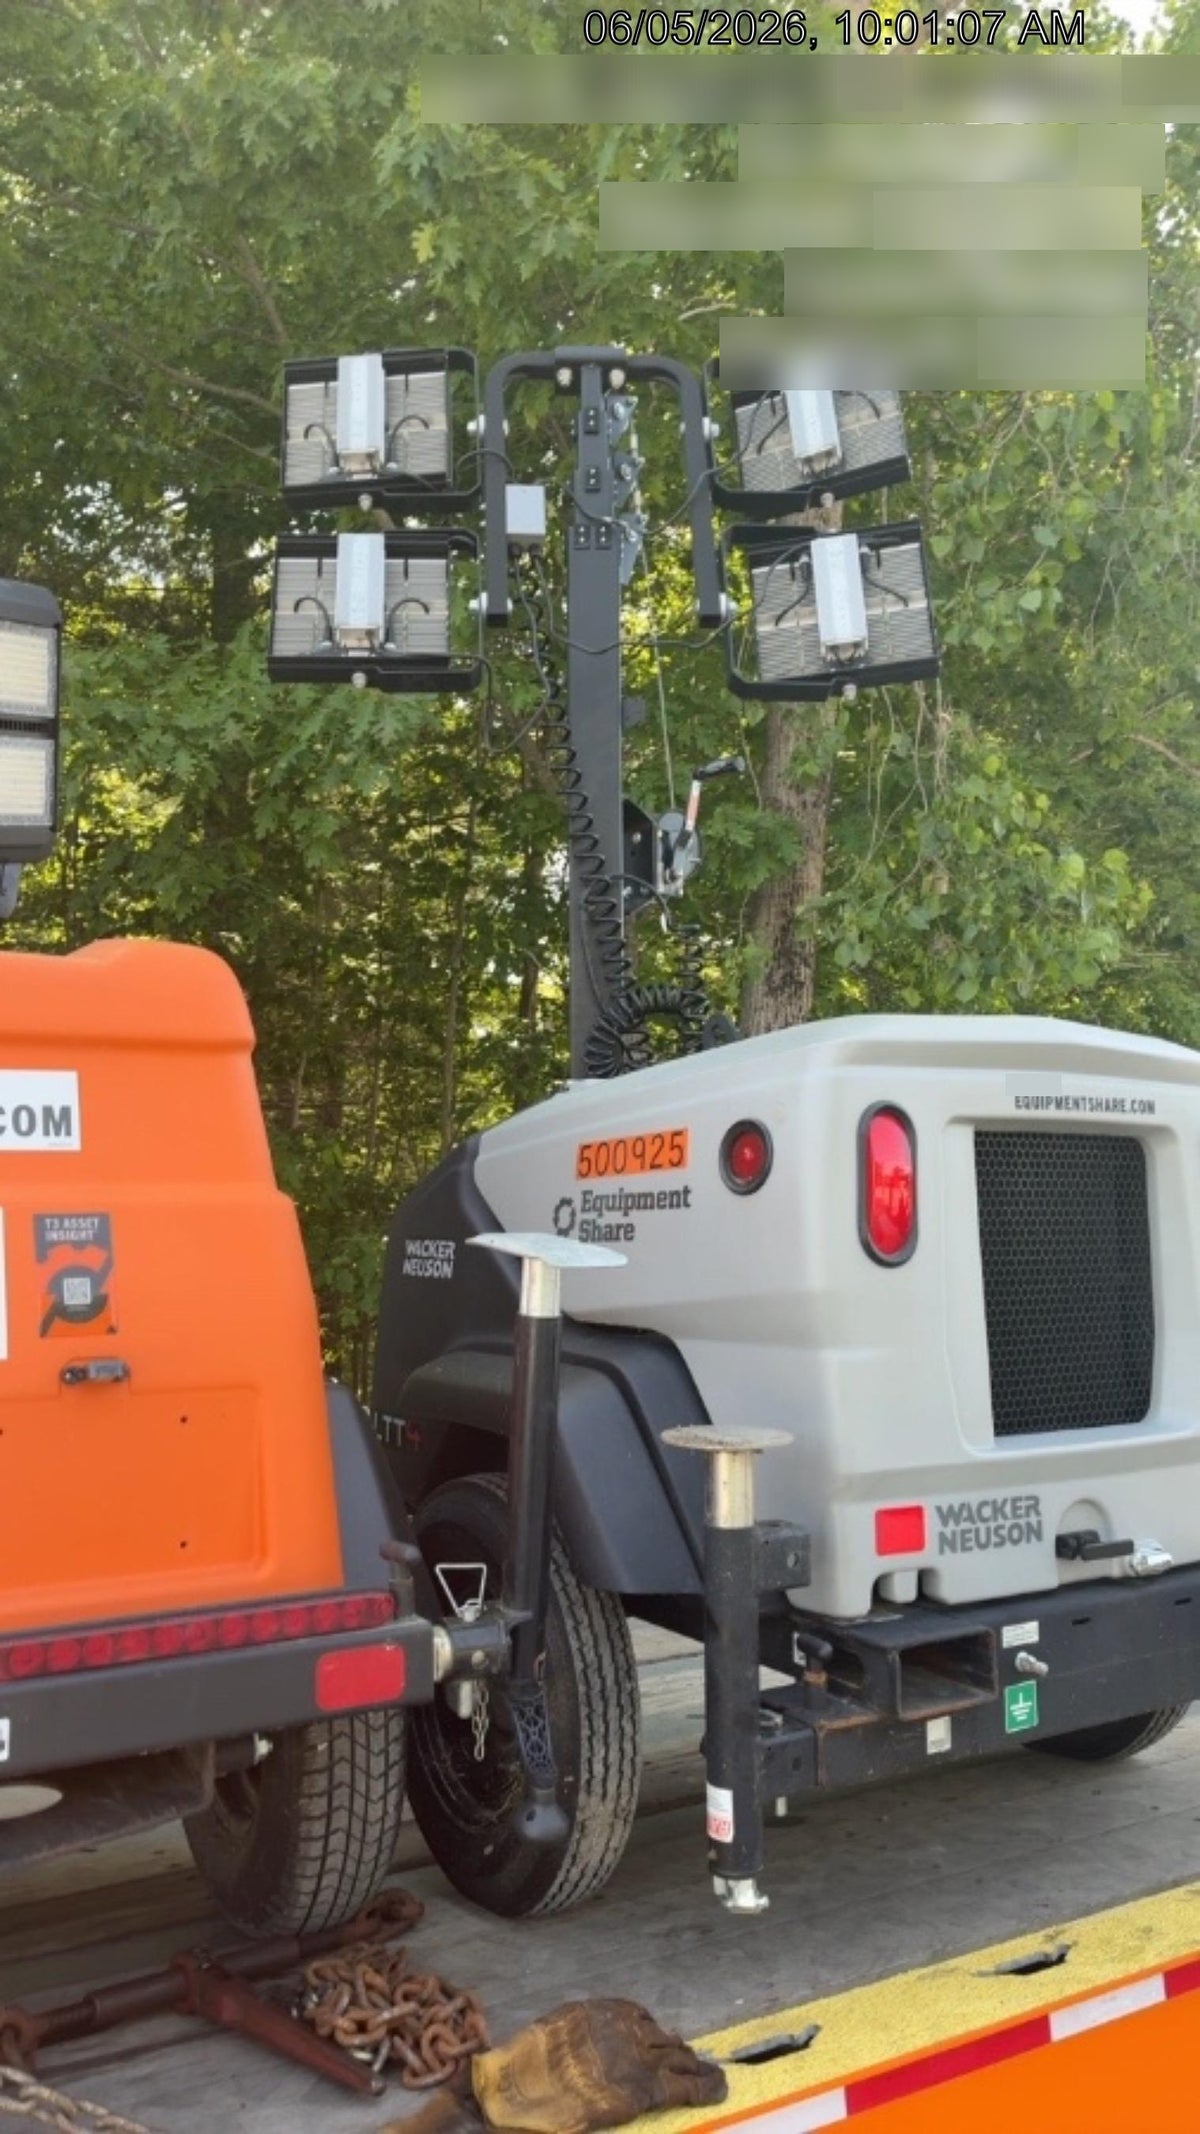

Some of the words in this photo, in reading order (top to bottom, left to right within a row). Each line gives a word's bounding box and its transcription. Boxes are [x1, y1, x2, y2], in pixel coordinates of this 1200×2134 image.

[1014, 1096, 1156, 1114] EQUIPMENTSHARE.COM
[0, 1104, 72, 1137] OM
[578, 1130, 684, 1178] 500925
[580, 1185, 692, 1217] Equipment
[45, 1230, 94, 1241] INSIGHT
[63, 1217, 98, 1230] ASSET
[578, 1219, 635, 1243] Share
[405, 1239, 456, 1260] WACKER
[403, 1258, 454, 1279] NEUSON
[935, 1494, 1041, 1528] WACKER
[938, 1519, 1043, 1555] NEUSON
